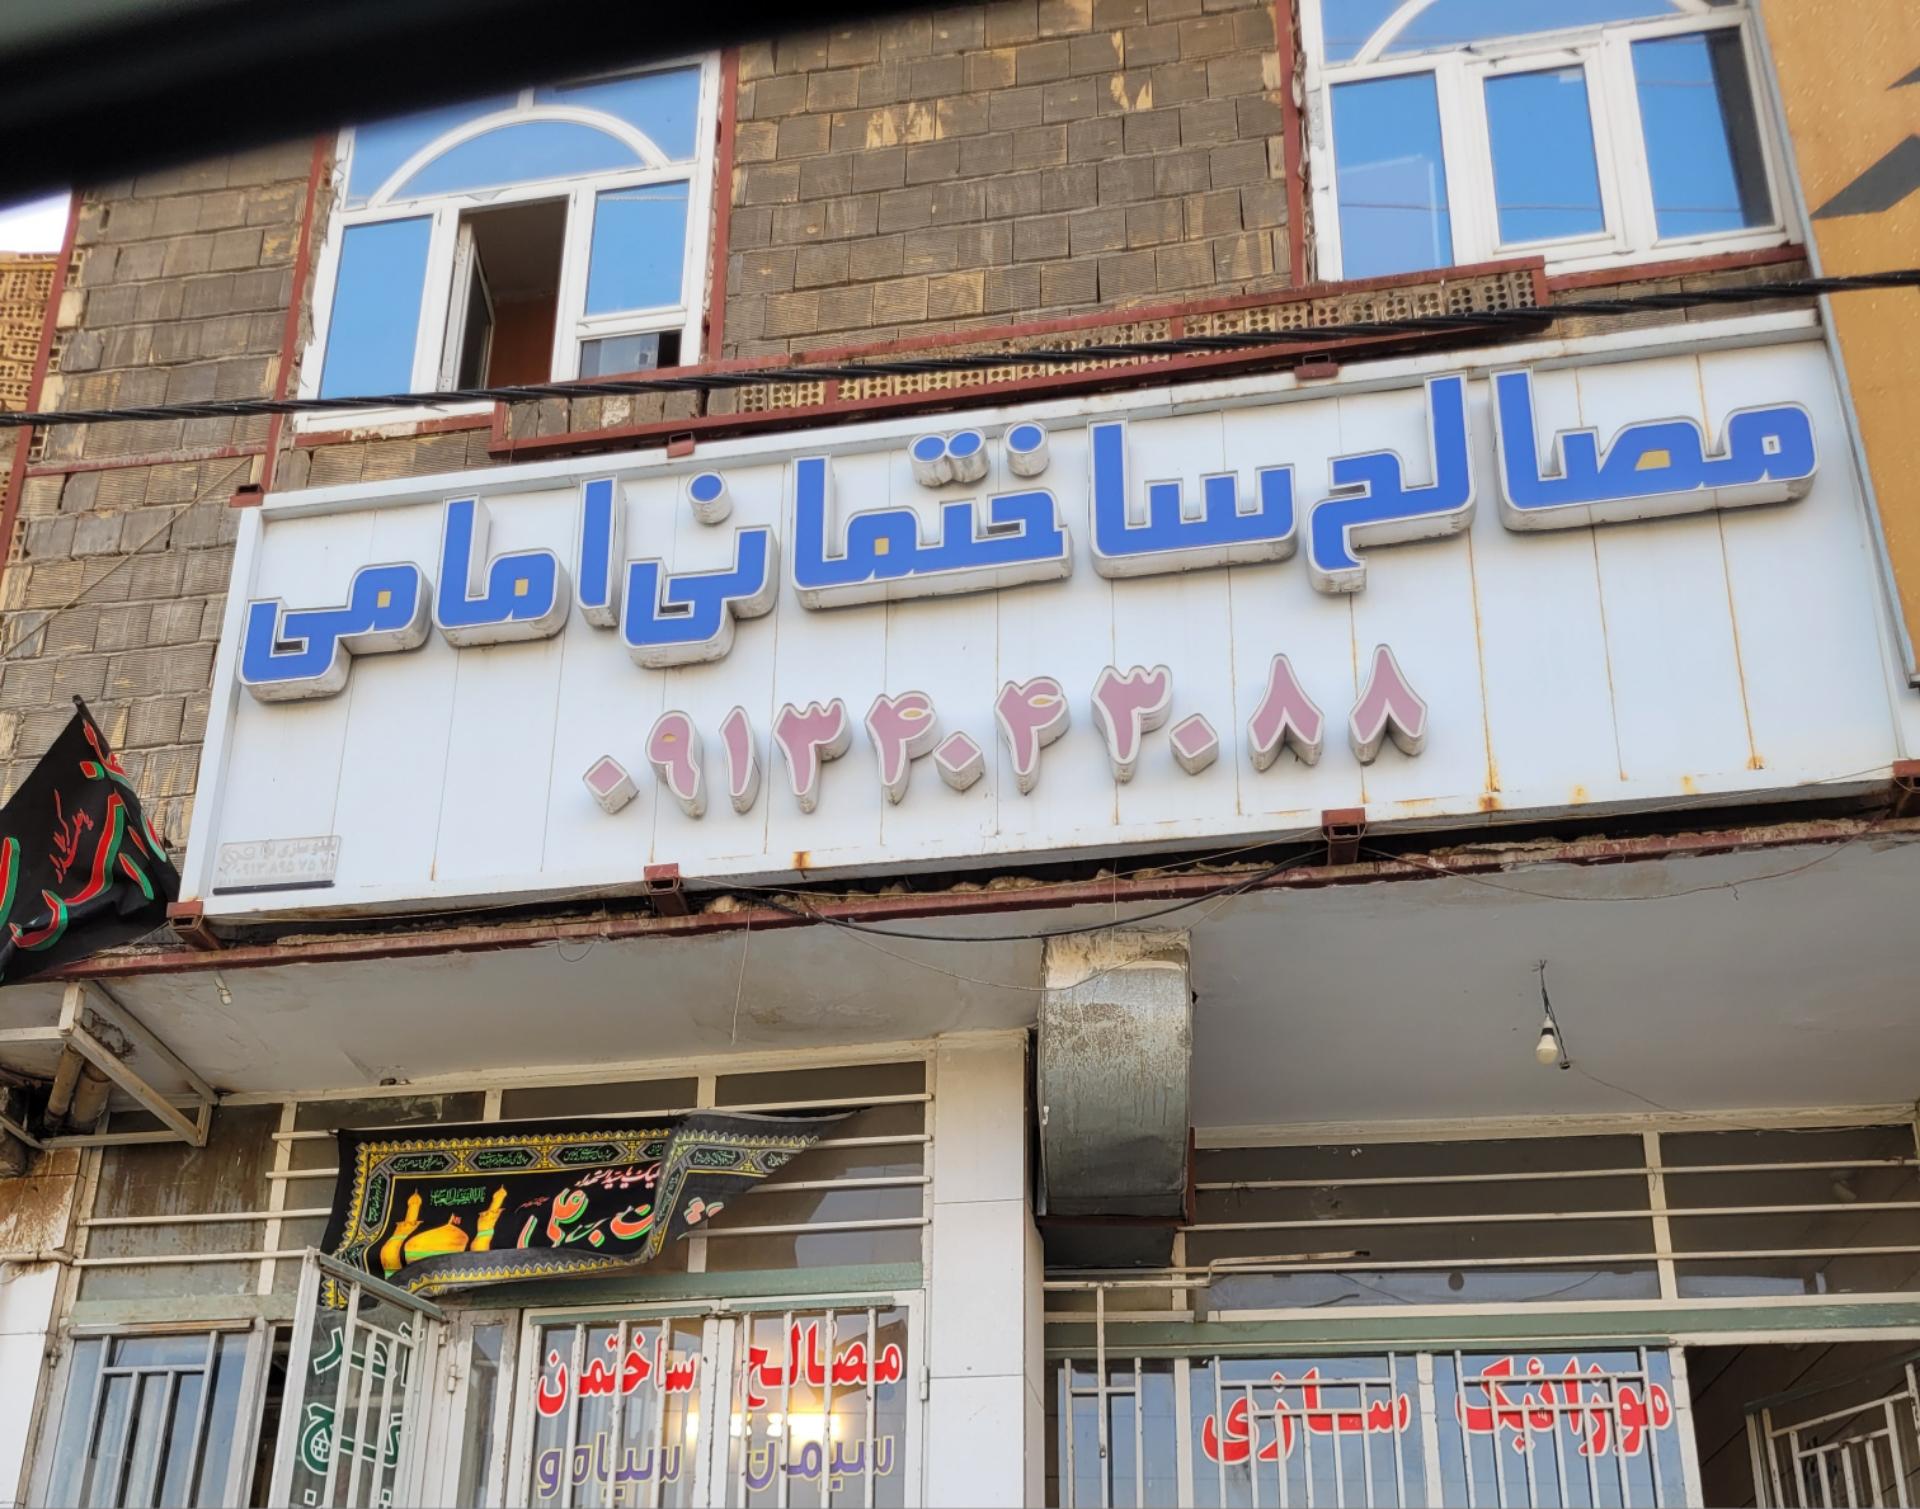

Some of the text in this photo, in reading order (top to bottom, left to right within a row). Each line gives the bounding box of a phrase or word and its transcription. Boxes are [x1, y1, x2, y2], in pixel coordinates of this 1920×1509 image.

[240, 369, 1819, 692] مصالح ساختمانی امامی
[583, 643, 1428, 812] ۰۹۱۳۴۰۴۳۰۸۸
[537, 1320, 903, 1417] مصالح ساختمن
[1202, 1366, 1411, 1465] سازی
[745, 1435, 895, 1492] سیمن
